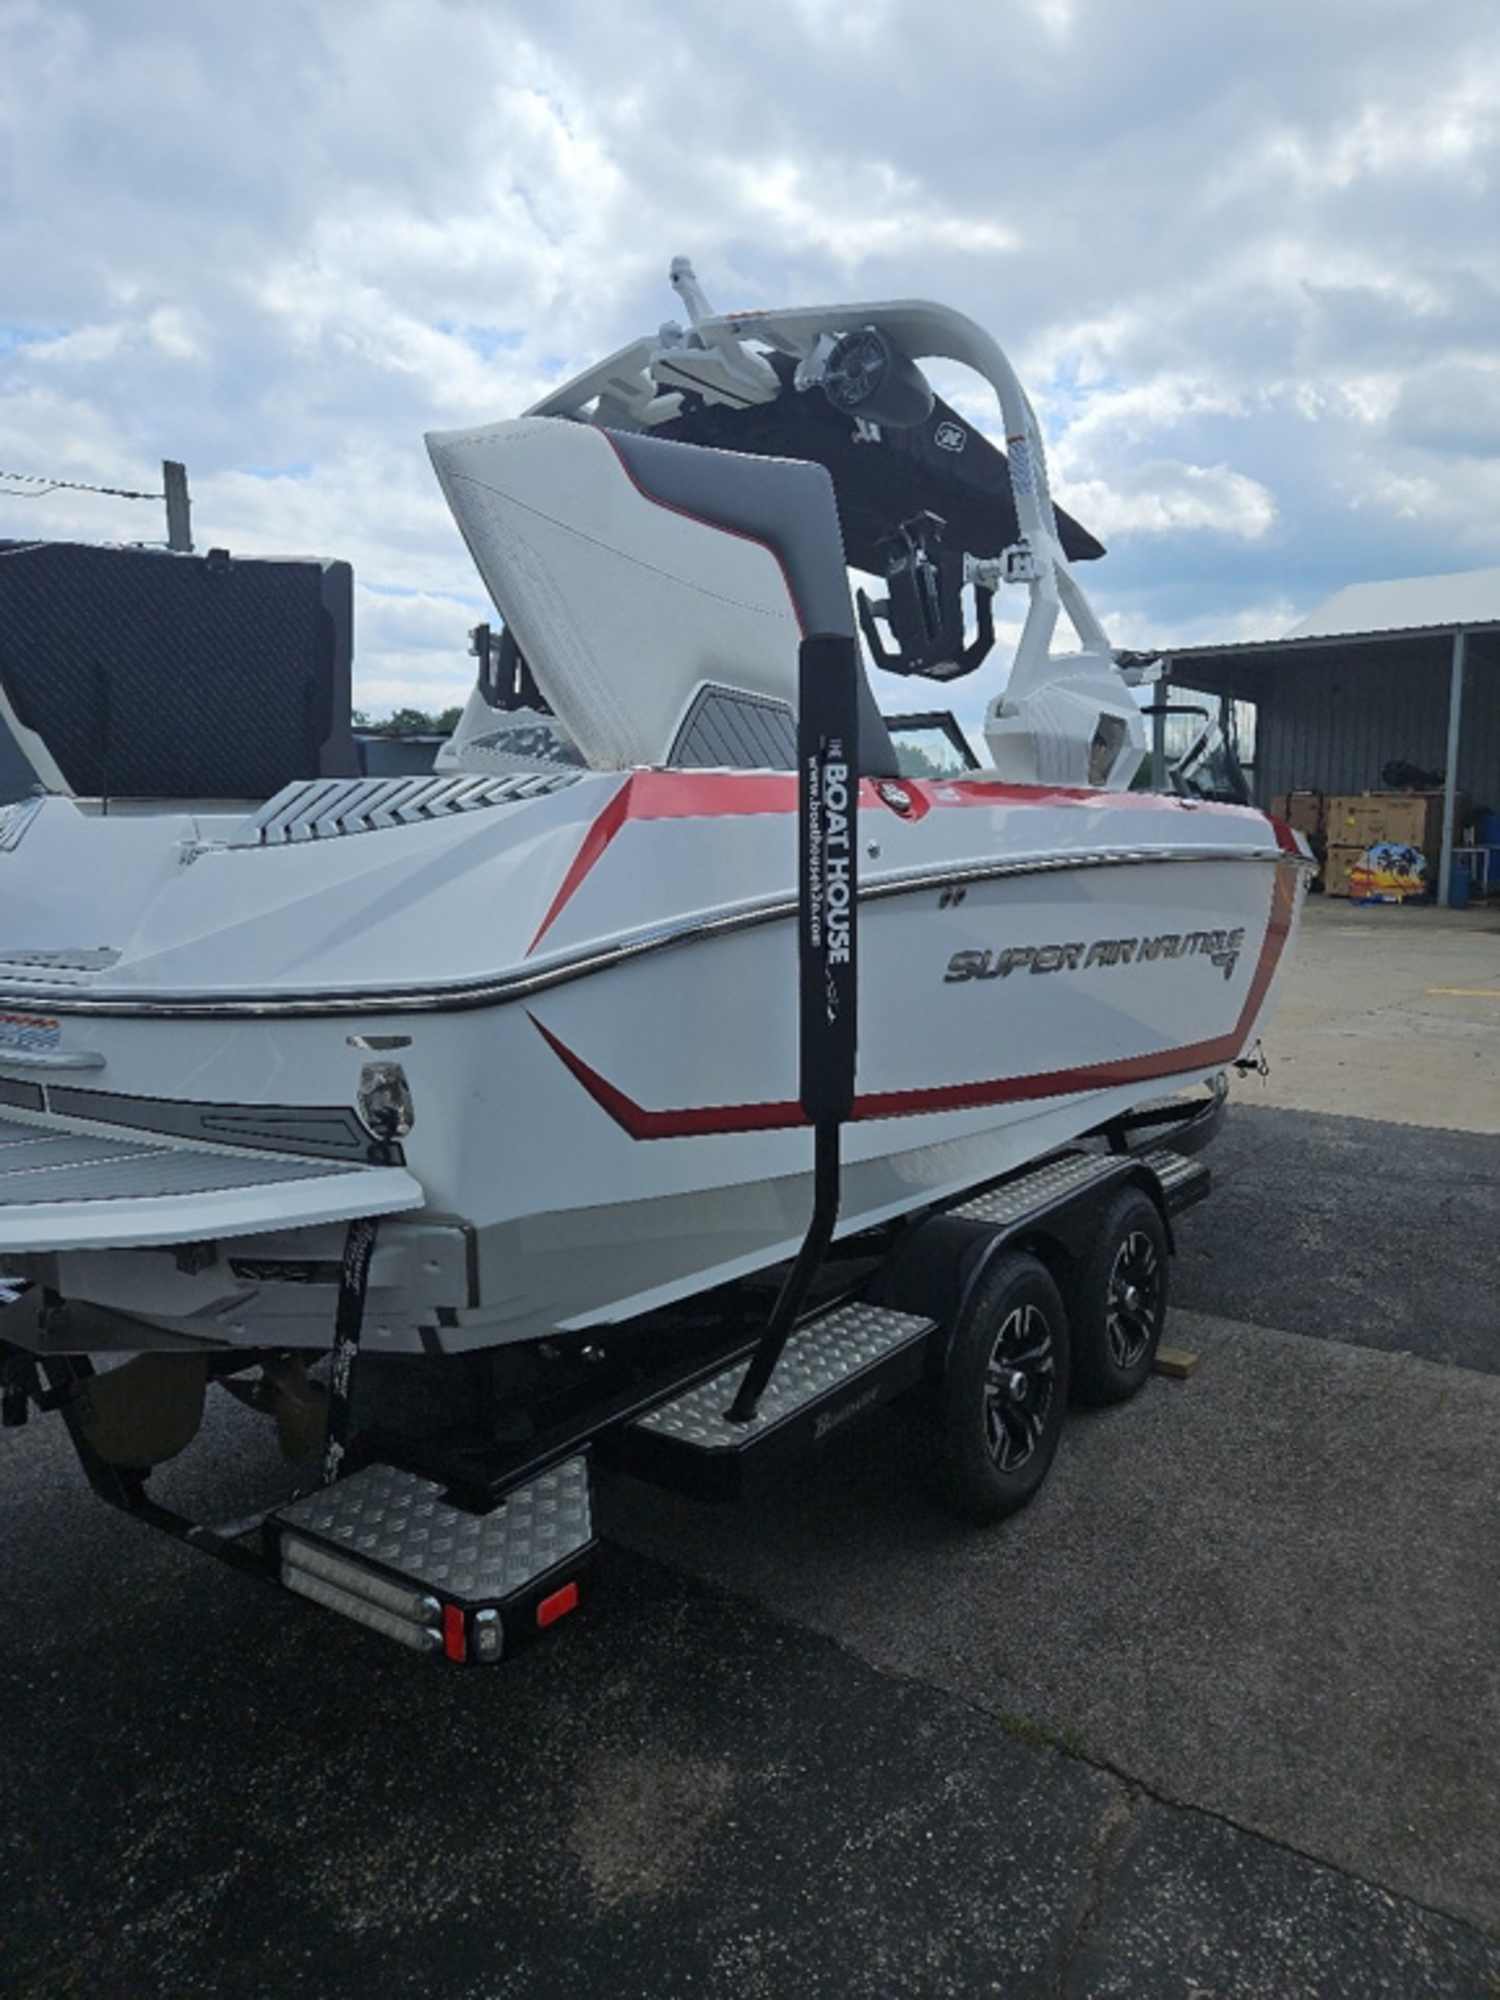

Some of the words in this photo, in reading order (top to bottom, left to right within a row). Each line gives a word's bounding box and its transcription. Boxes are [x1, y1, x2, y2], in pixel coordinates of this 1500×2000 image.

[827, 738, 843, 759] THE
[826, 764, 850, 850] BOAT
[826, 856, 850, 965] HOUSE
[943, 942, 1087, 983] SUPER
[1083, 937, 1140, 969] AIR
